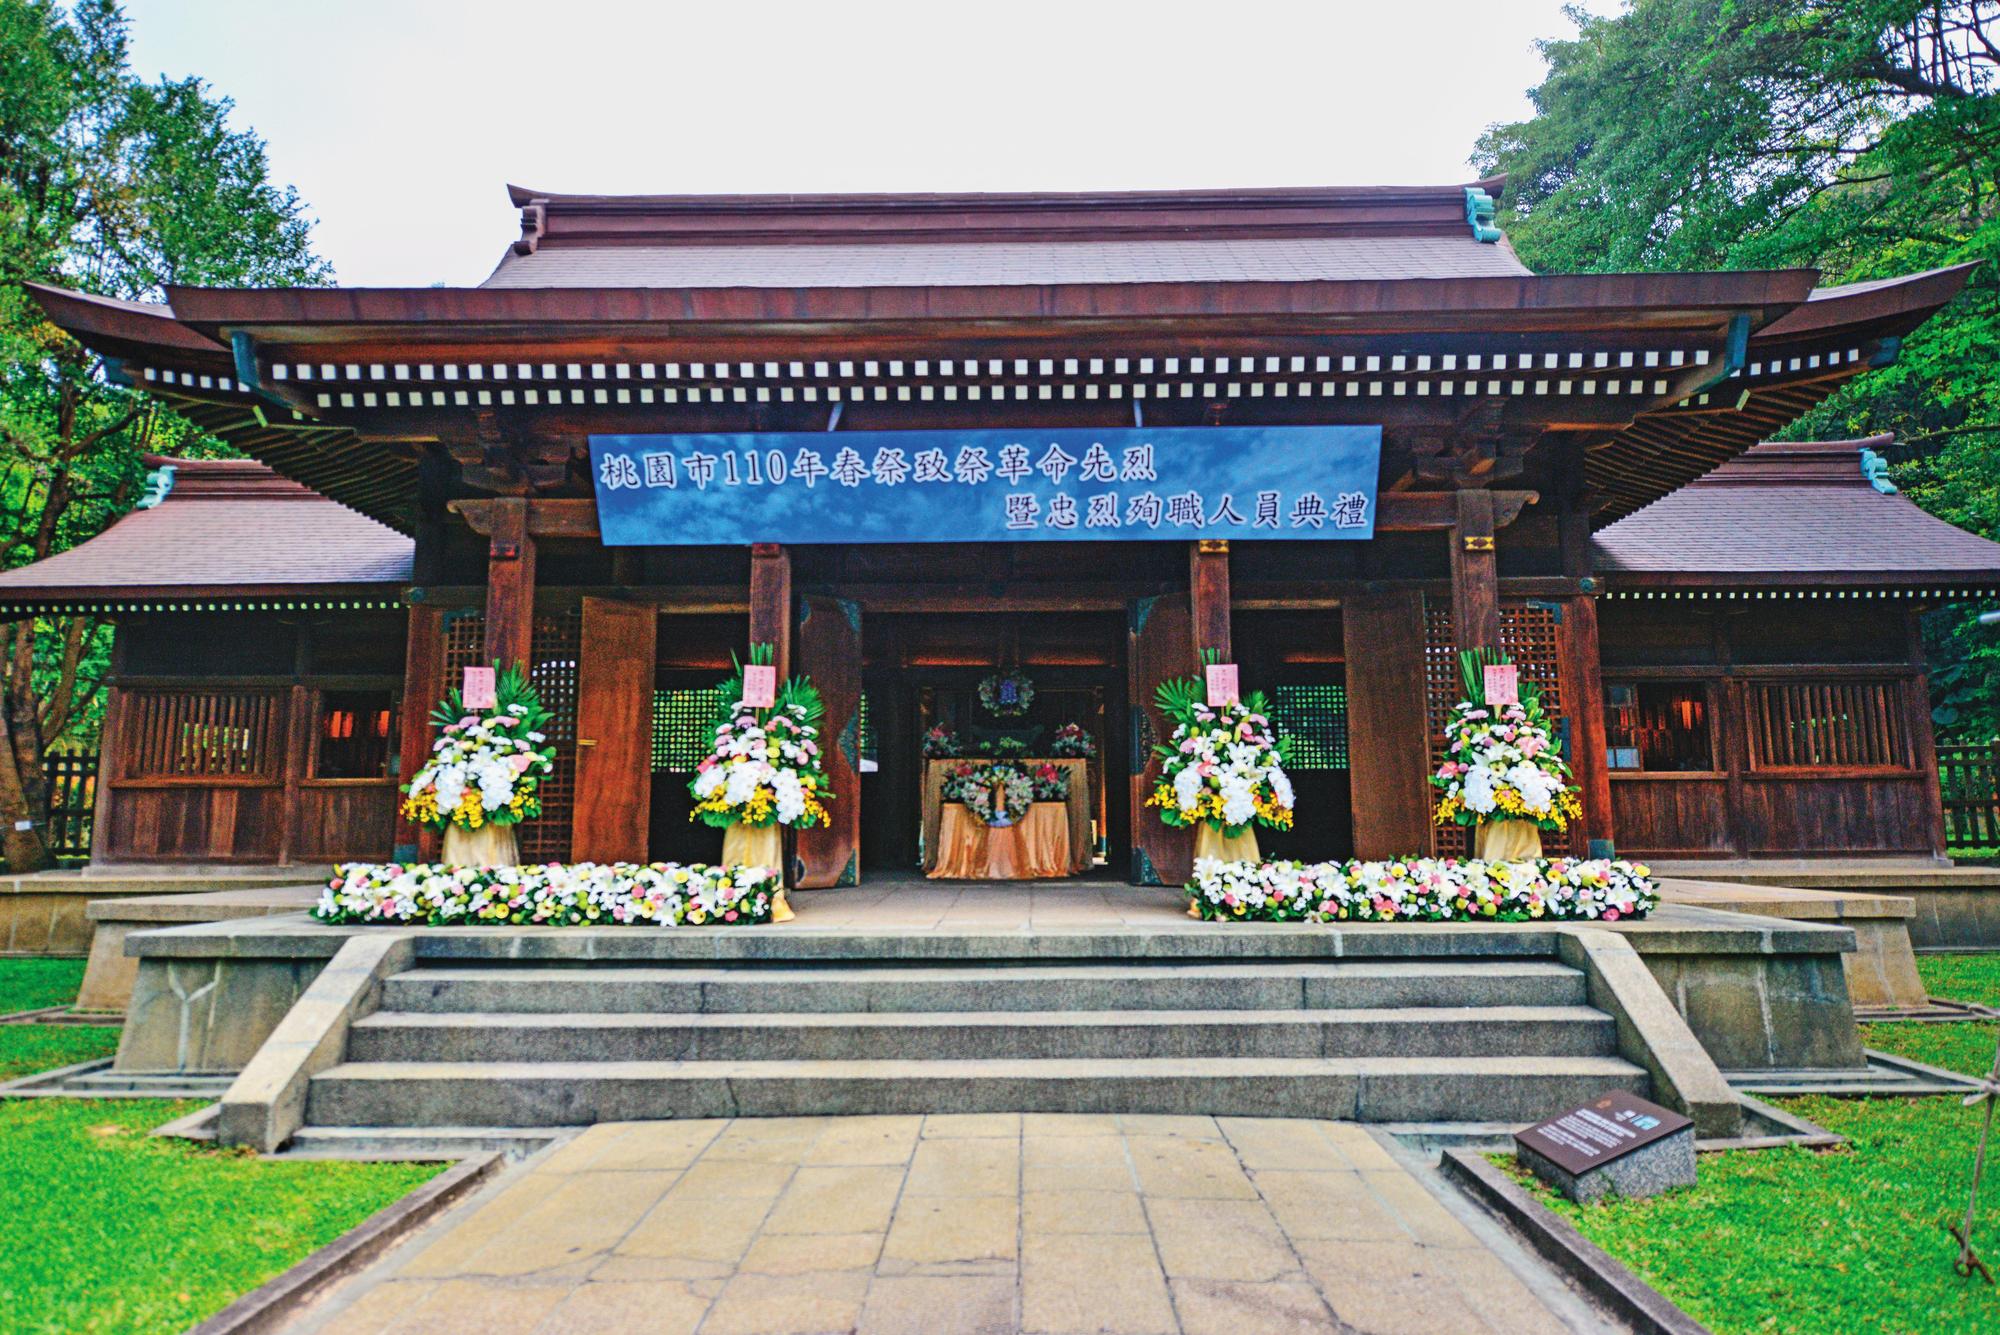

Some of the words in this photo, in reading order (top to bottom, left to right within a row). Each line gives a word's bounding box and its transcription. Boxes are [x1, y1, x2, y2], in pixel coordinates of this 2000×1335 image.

[599, 443, 1158, 491] 桃園市110年春祭致祭革命先烈
[1004, 490, 1371, 532] 暨忠烈殉職人員典禮
